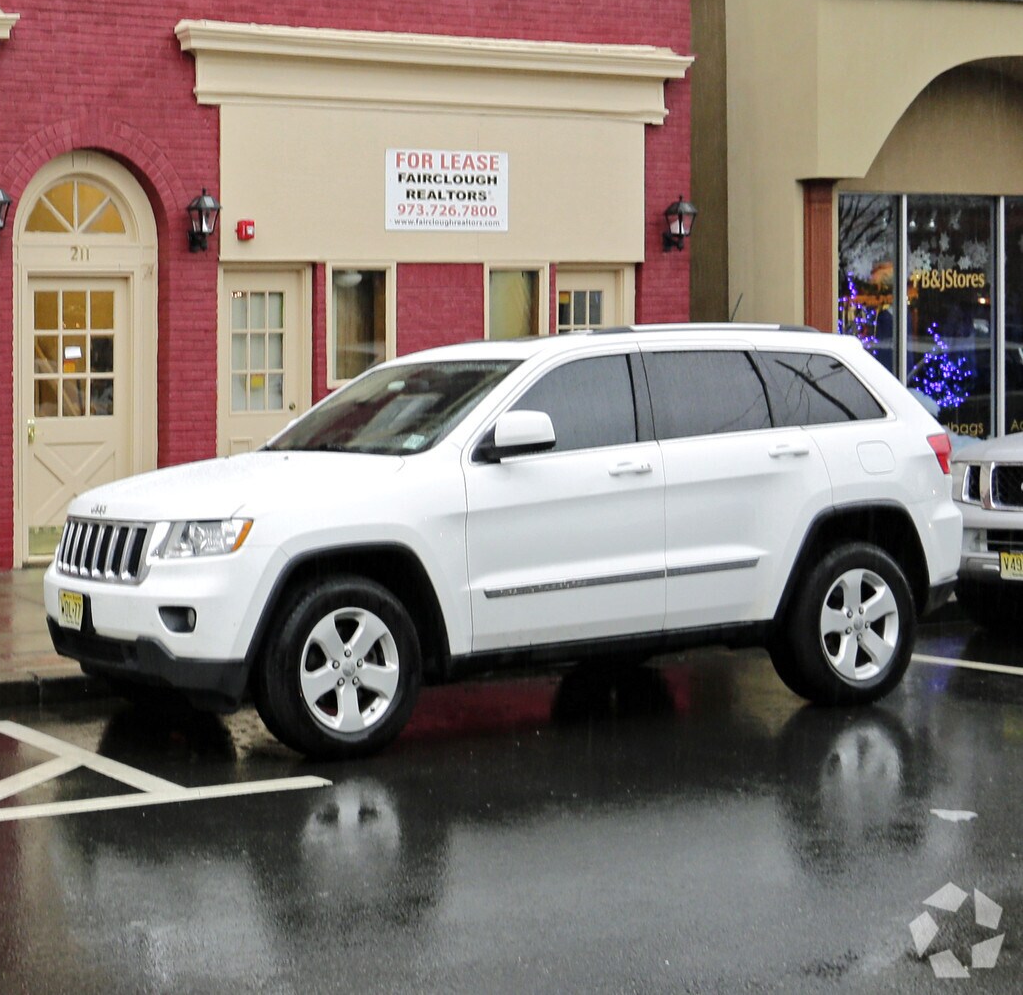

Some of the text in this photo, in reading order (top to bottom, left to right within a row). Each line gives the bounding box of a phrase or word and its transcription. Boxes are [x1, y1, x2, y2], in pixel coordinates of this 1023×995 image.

[395, 151, 499, 171] FOR LEASE
[398, 172, 497, 186] FAIRCLOUGH
[406, 189, 487, 201] REALTORS
[397, 204, 497, 217] 973.726.7800
[70, 245, 90, 262] 211
